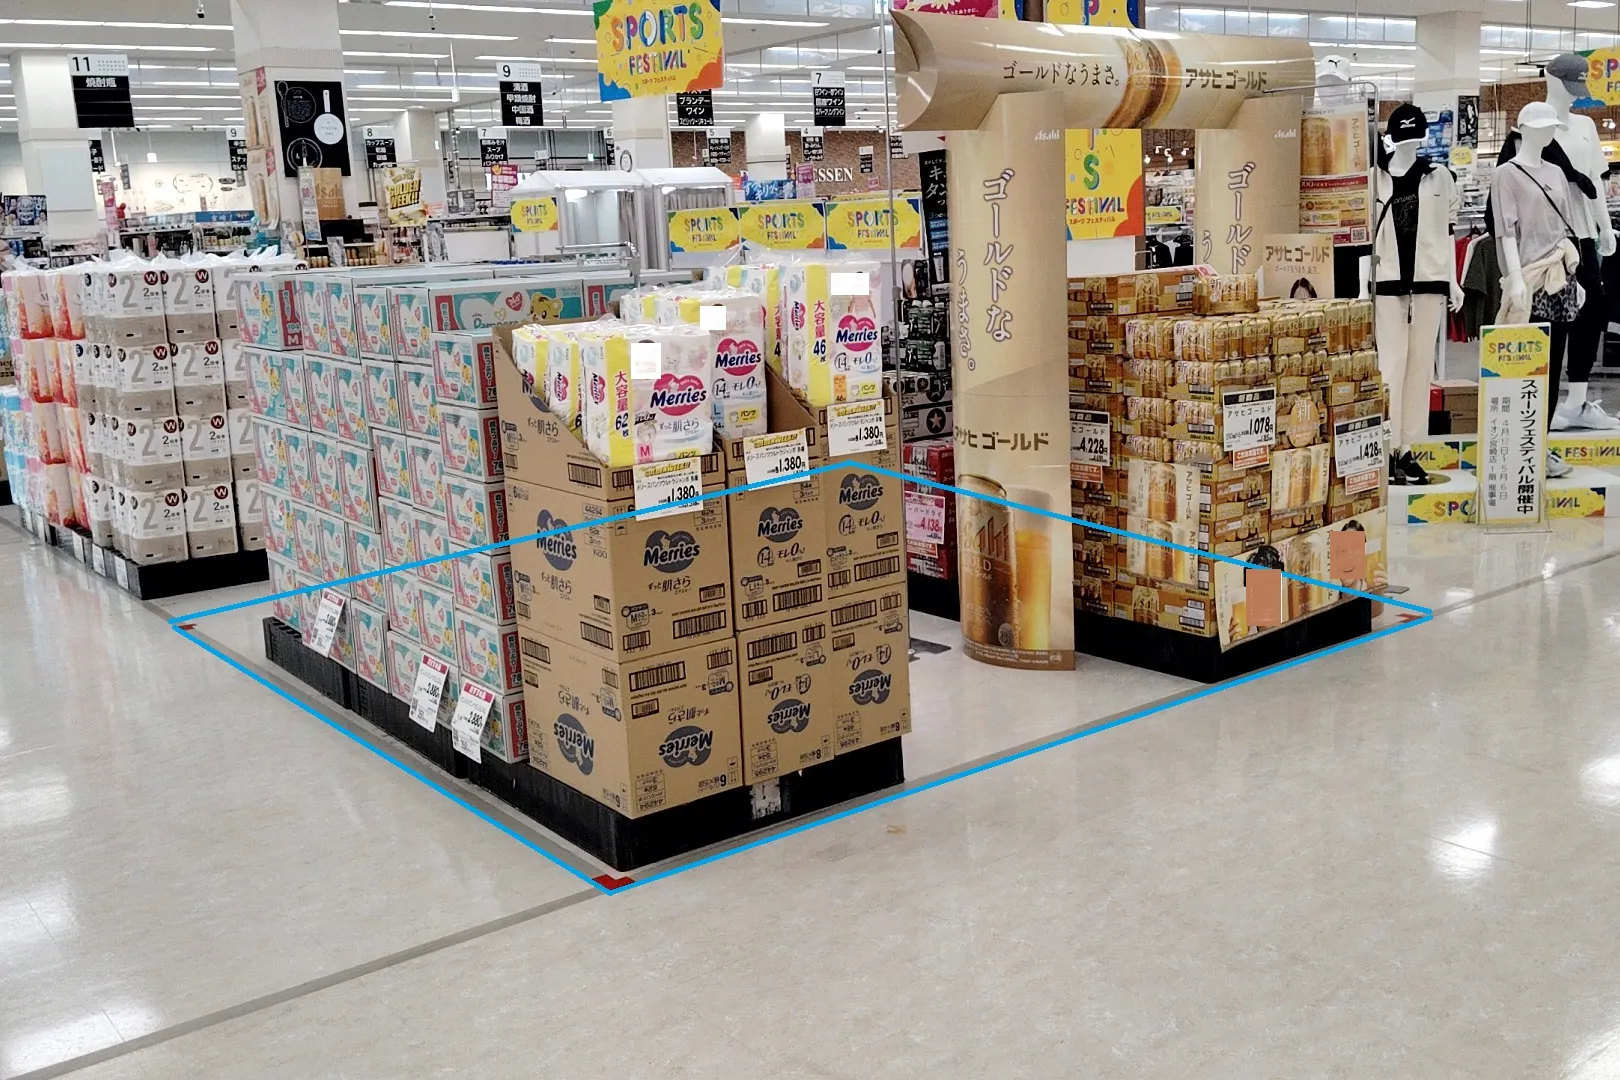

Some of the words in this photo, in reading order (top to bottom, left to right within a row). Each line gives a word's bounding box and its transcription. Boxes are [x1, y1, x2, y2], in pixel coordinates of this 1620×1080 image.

[610, 2, 704, 52] SPORTS
[72, 56, 91, 72] 11
[503, 64, 511, 77] 9
[629, 49, 687, 75] FESTIVAL
[815, 73, 822, 84] 7
[1002, 60, 1120, 87] ゴールドなうまさ。
[1185, 68, 1267, 90] アサヒゴールド
[511, 104, 534, 114] 中国酒
[679, 97, 711, 105] ブランデー
[686, 107, 705, 115] ワイン
[230, 128, 237, 138] 9
[367, 128, 373, 137] 8
[481, 129, 487, 137] 7
[1034, 130, 1061, 141] Asahi
[231, 155, 247, 163] スナッ
[389, 180, 421, 196] GOLDEN
[390, 192, 420, 209] WEEK!!
[684, 217, 724, 233] SPORTS
[758, 211, 805, 229] SPORTS
[847, 208, 899, 227] SPORTS
[983, 167, 1016, 342] ゴールドな
[1265, 245, 1330, 263] アサヒゴールド
[145, 273, 157, 282] W
[197, 271, 207, 279] W
[119, 275, 139, 308] 2
[171, 272, 188, 306] 2
[814, 300, 826, 338] 大容量
[288, 334, 299, 346] M
[836, 327, 878, 344] Merries
[155, 348, 167, 357] W
[206, 343, 217, 351] W
[1488, 339, 1543, 355] SPORTS
[128, 350, 147, 383] 2
[181, 344, 198, 377] 2
[715, 350, 762, 370] Merries
[615, 371, 629, 411] 大容量
[649, 387, 707, 409] Merries
[713, 403, 722, 416] L
[739, 408, 758, 418] パンツ
[1227, 404, 1272, 418] アサヒゴールド
[1294, 398, 1310, 422] 新
[1490, 397, 1499, 413] 場所
[1501, 396, 1511, 413] 期間
[165, 421, 176, 430] W
[212, 417, 223, 426] W
[527, 416, 559, 437] ずっと肌さら
[659, 419, 700, 433] ずっと肌さら
[139, 423, 157, 456] 2
[186, 419, 205, 451] 2
[954, 425, 1049, 452] アサヒゴールド
[639, 445, 651, 457] M
[1516, 379, 1538, 515] スポーツフェスティバル開催中
[167, 495, 177, 504] W
[216, 488, 226, 497] W
[839, 486, 884, 505] Merries
[140, 498, 158, 529] 2
[190, 491, 209, 522] 2
[757, 518, 803, 537] Merries
[536, 528, 577, 560] Merries
[643, 543, 700, 566] Merries
[541, 571, 572, 594] ずっと肌さら
[648, 576, 691, 592] ずっと肌さら
[849, 674, 892, 695] Merries
[767, 703, 811, 724] Merries
[553, 721, 595, 759] Merries
[658, 730, 714, 757] Merries
